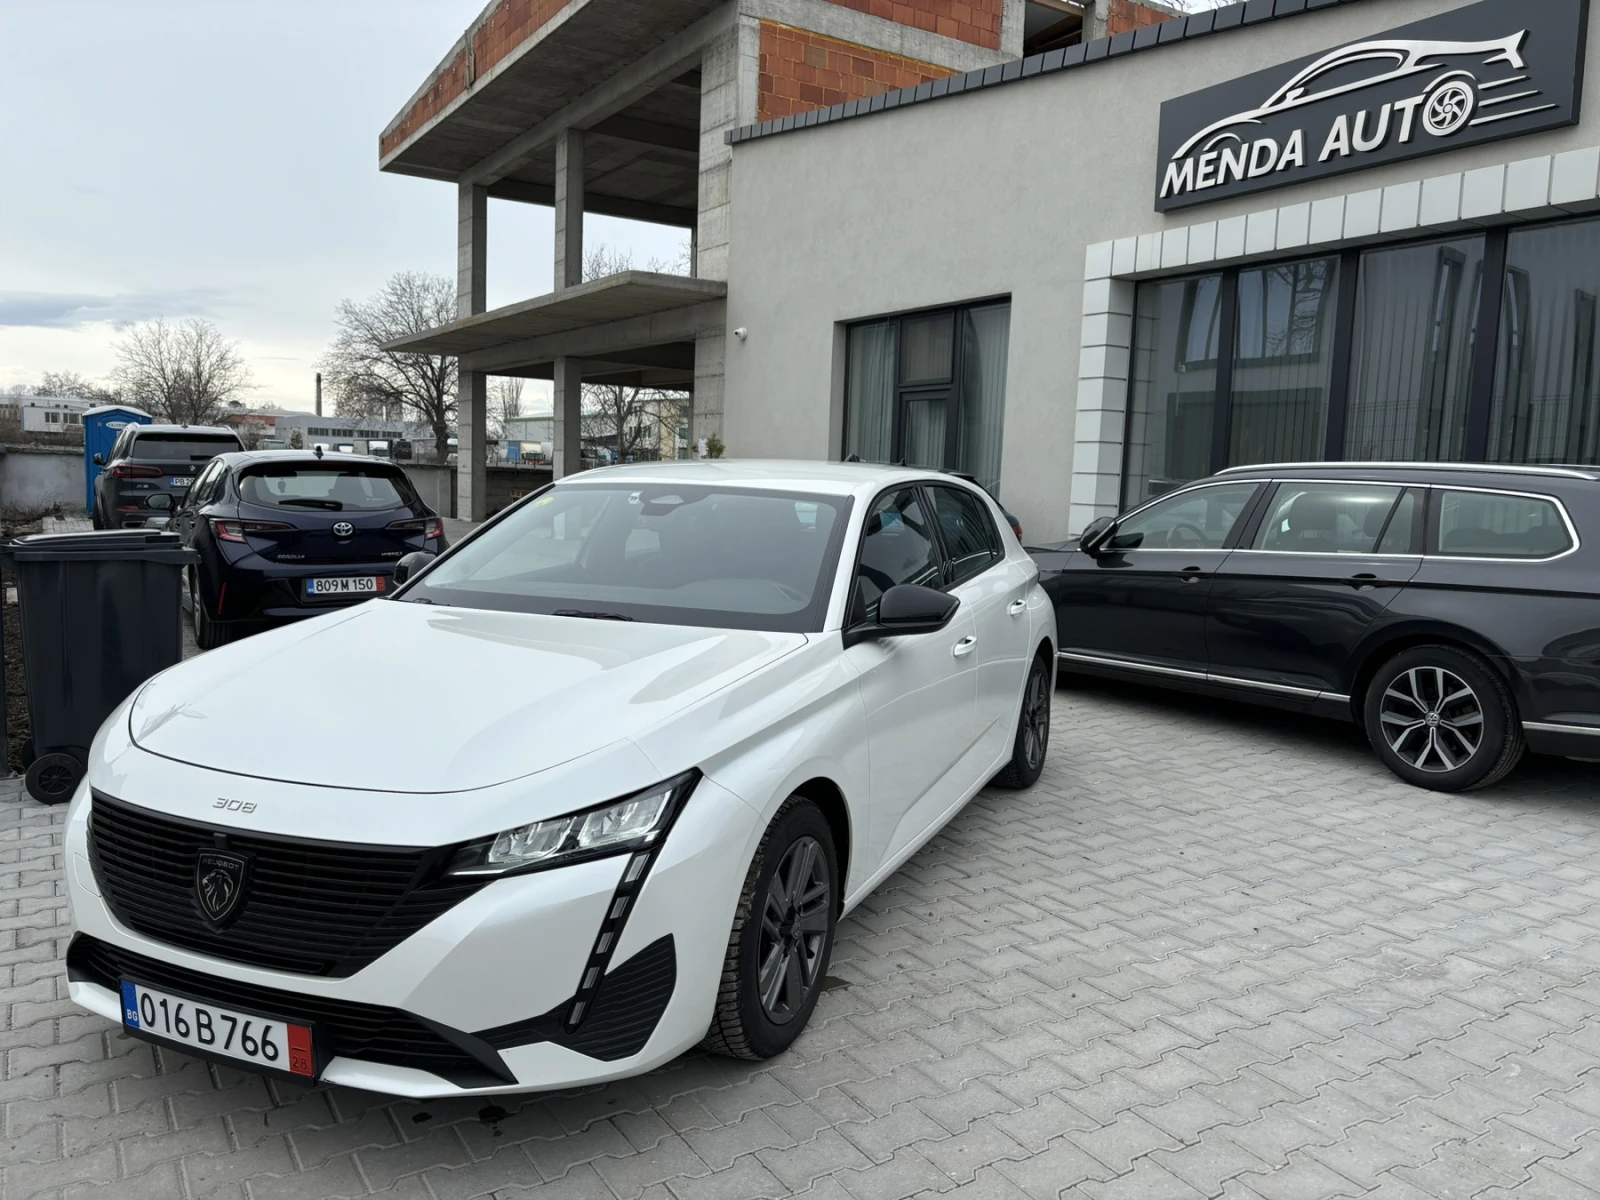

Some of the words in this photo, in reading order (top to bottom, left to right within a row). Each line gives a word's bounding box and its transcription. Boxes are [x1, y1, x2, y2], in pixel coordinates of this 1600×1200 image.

[1159, 129, 1306, 198] MENDA
[1318, 80, 1476, 162] AUTO
[316, 579, 339, 592] 809
[352, 578, 374, 591] 150
[212, 797, 257, 814] 308
[126, 1009, 138, 1022] BG
[141, 992, 279, 1061] 016B766
[292, 1055, 307, 1070] 28
